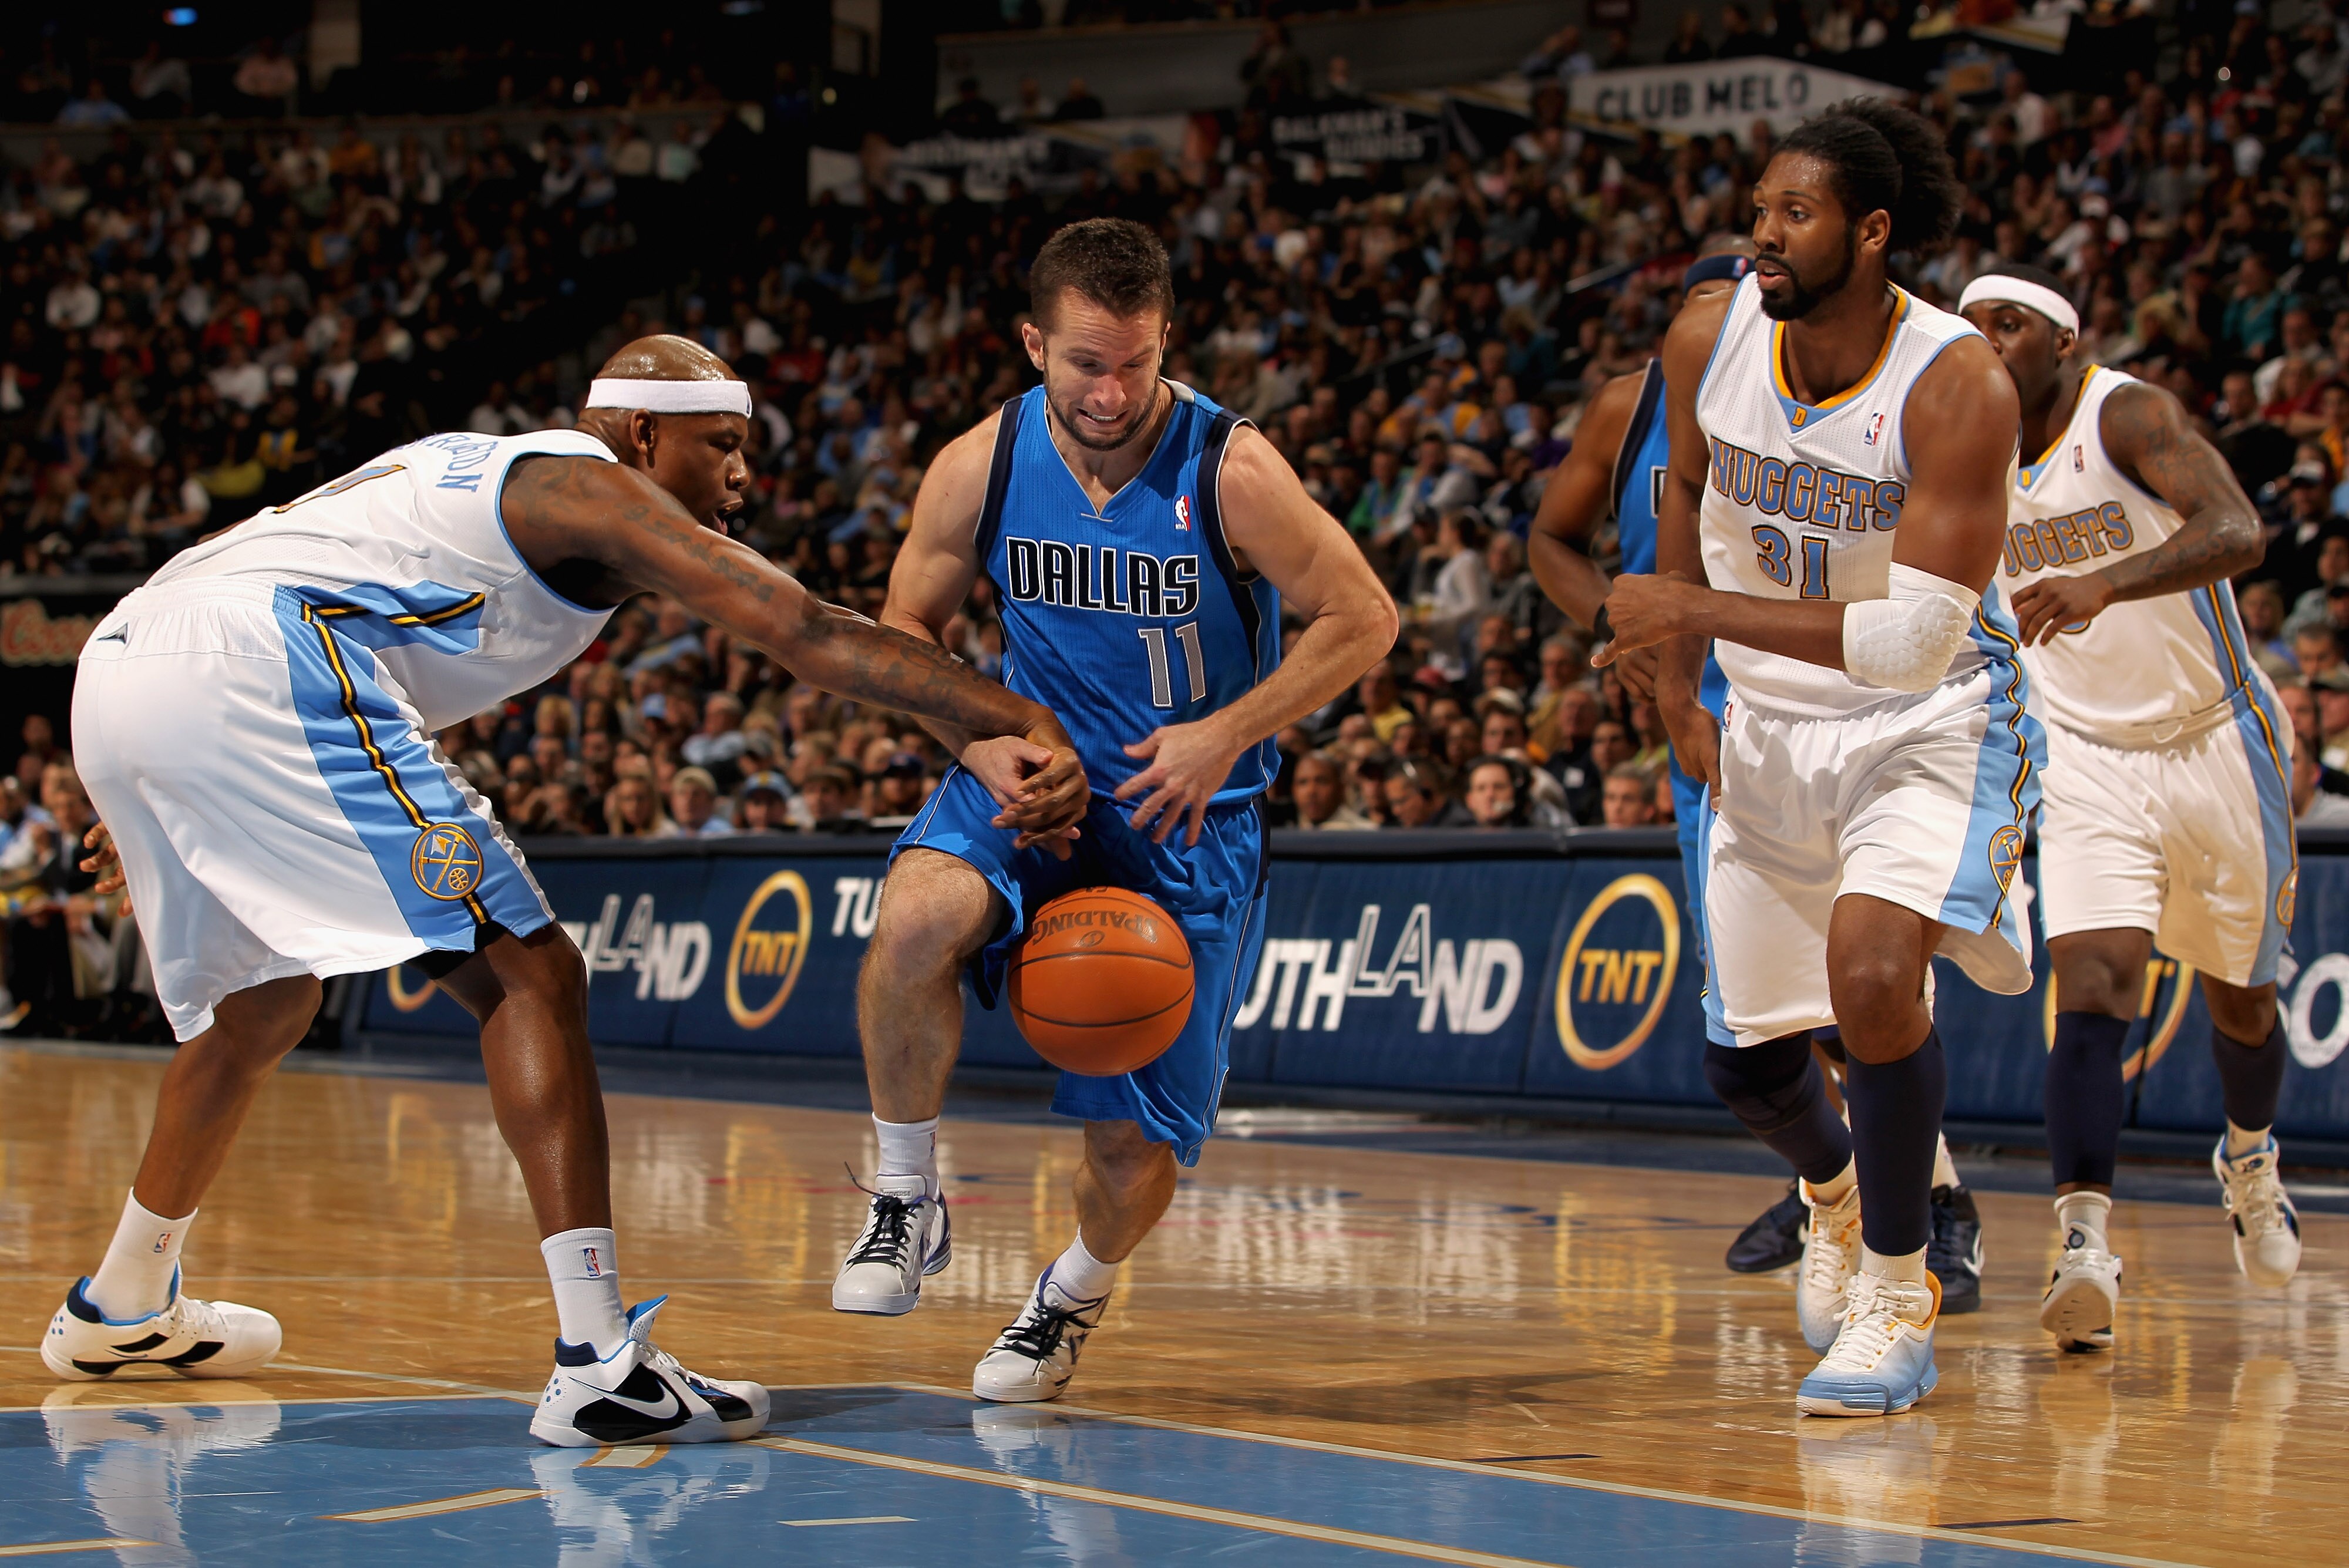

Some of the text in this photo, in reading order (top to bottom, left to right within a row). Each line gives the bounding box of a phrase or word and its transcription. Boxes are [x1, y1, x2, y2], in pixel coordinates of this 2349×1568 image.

[1596, 70, 1810, 120] CLUB MELO
[1710, 435, 1907, 531] NUGGETS
[1006, 536, 1199, 617] DALLAS
[1751, 524, 1830, 600] 31
[1138, 621, 1206, 708] 11
[741, 930, 798, 977] TNT
[1032, 911, 1159, 946] SPALDING
[1577, 948, 1664, 1004] TNT
